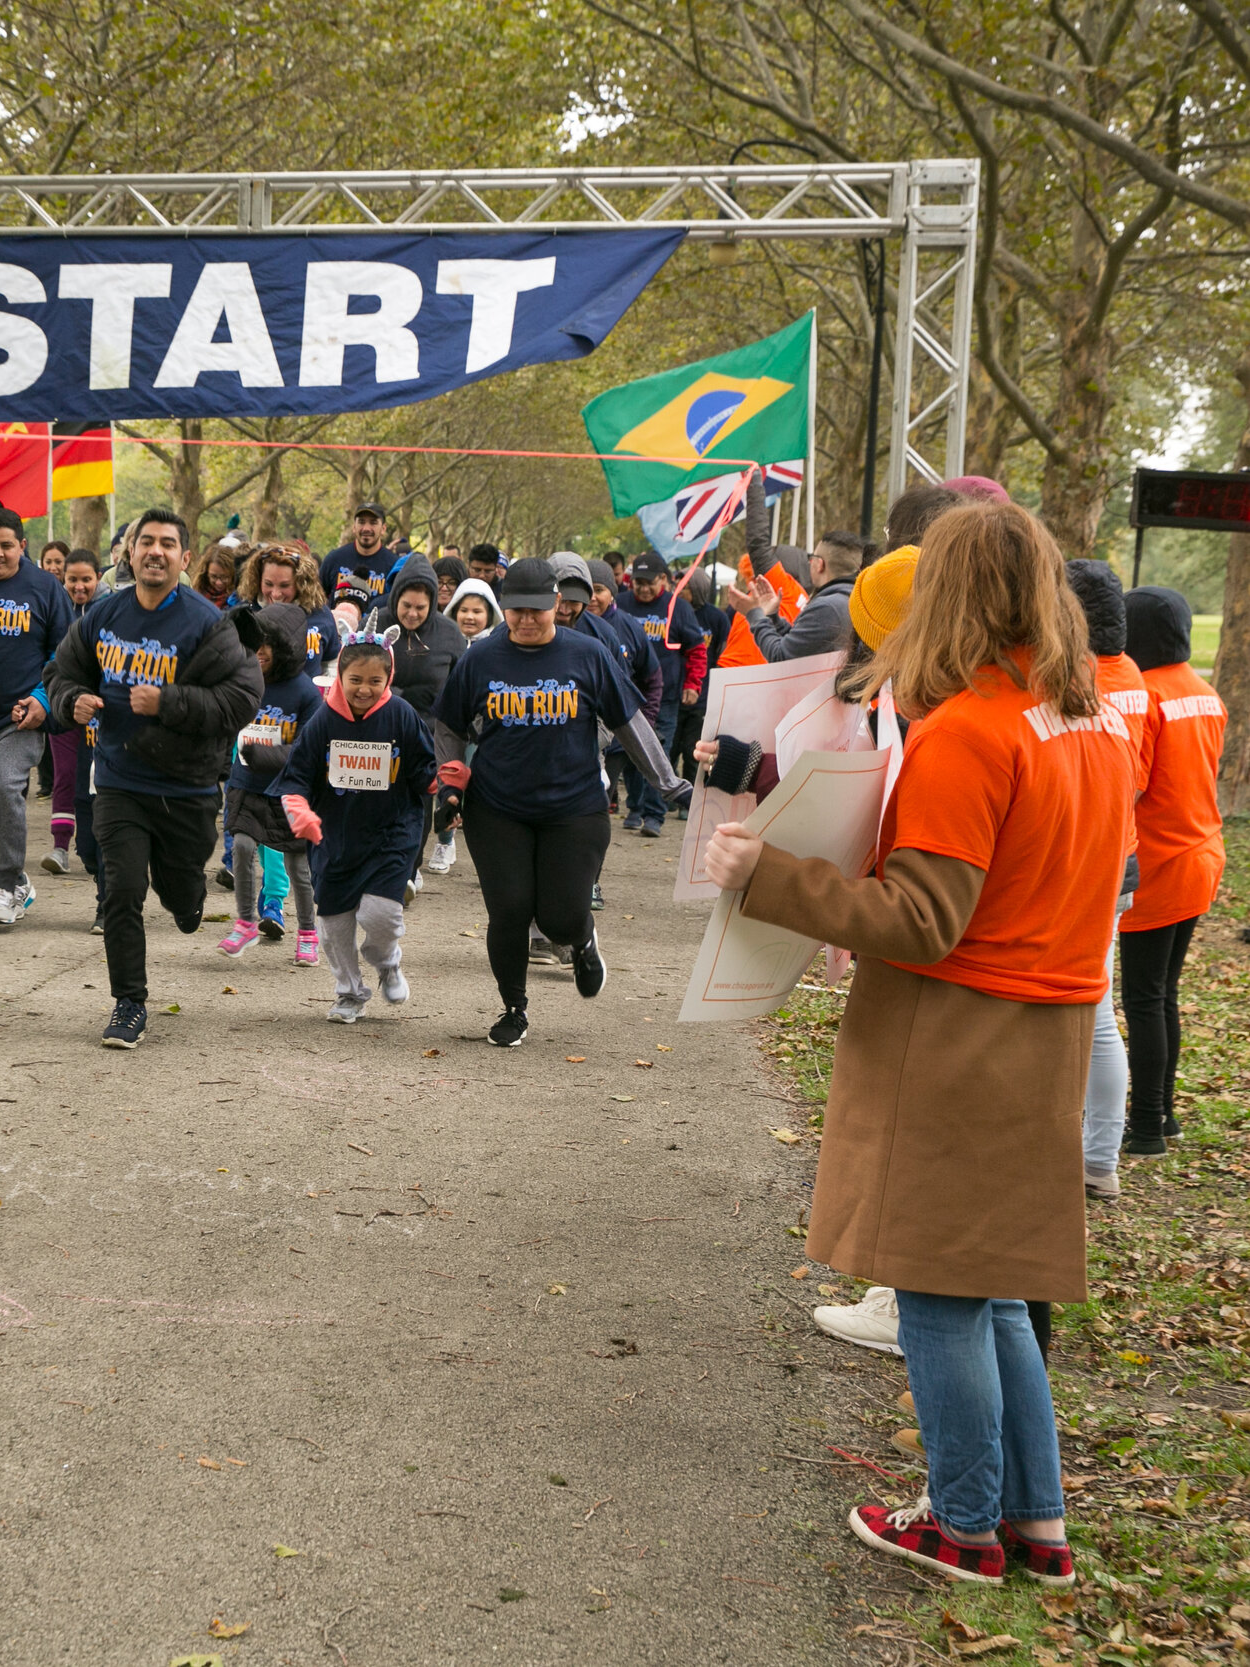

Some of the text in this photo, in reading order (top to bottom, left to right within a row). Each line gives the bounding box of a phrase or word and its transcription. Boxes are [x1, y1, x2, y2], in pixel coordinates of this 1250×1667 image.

[129, 648, 179, 685] RUN
[486, 689, 579, 720] FUN RUN
[1158, 695, 1224, 722] VOLUNTEER
[532, 712, 568, 726] 2019
[334, 741, 370, 750] CHICAGO
[338, 754, 382, 771] TWAIN
[348, 776, 382, 787] Fun Run
